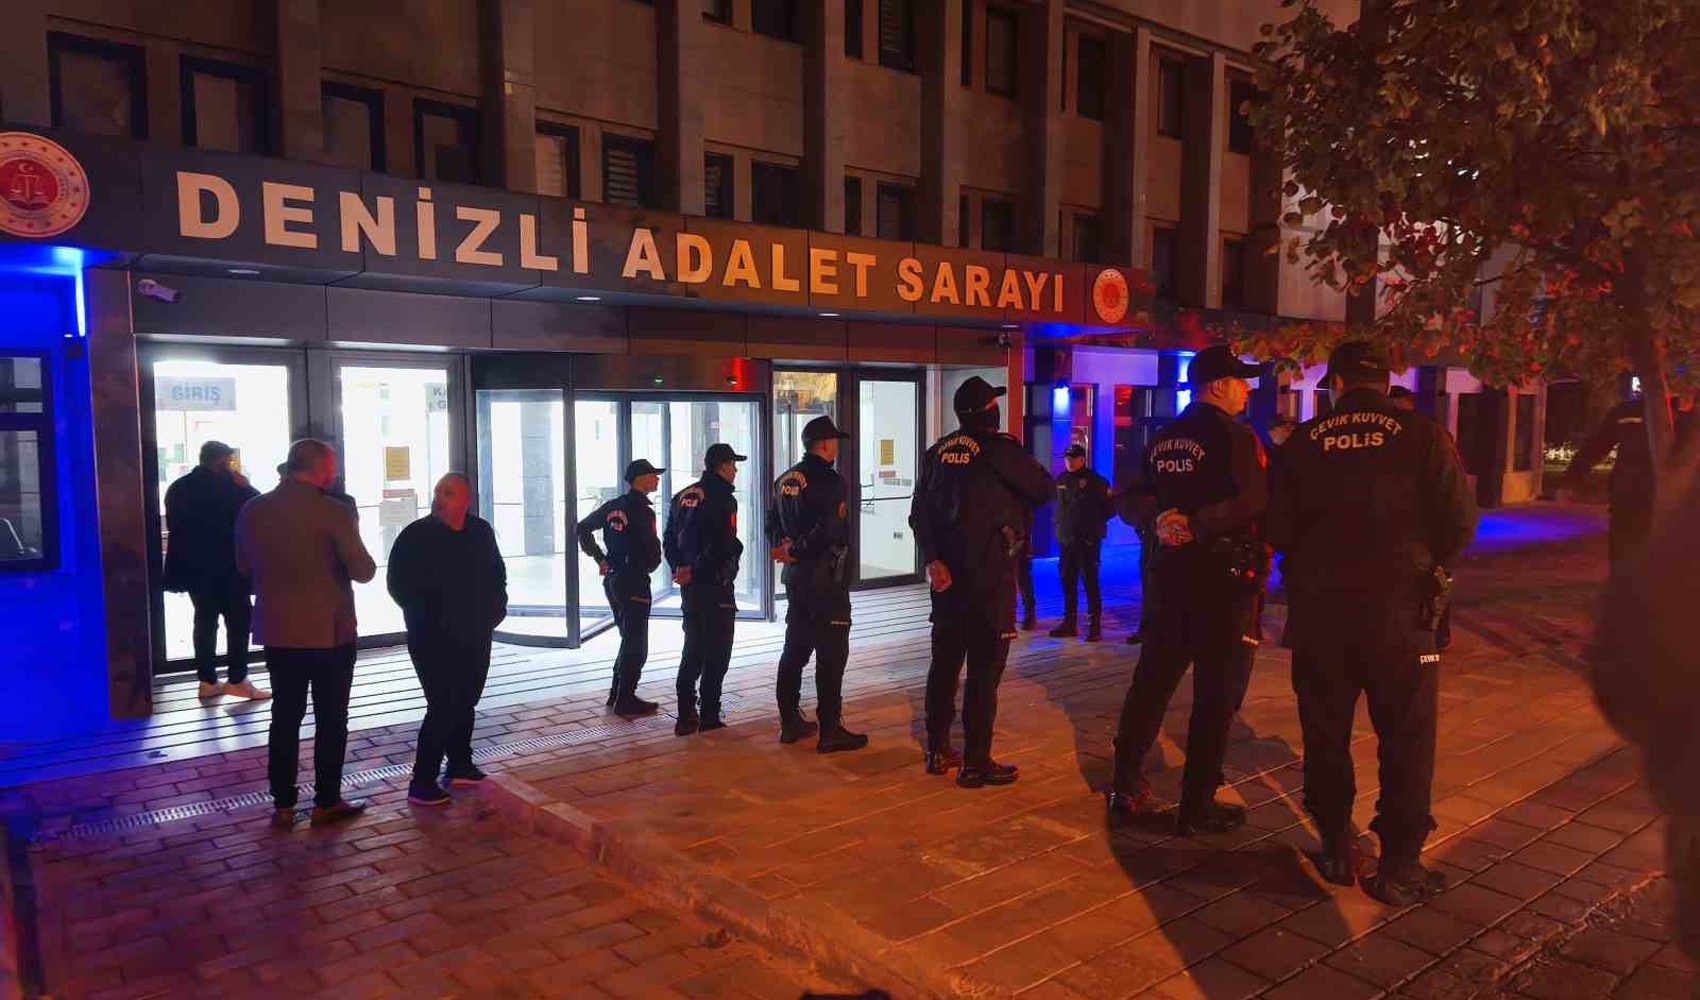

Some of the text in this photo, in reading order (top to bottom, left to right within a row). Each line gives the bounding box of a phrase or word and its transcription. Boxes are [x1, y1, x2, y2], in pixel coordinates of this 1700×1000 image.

[176, 171, 1063, 313] DENİZLİ ADALET SARAYI
[1352, 412, 1402, 435] KUVVET
